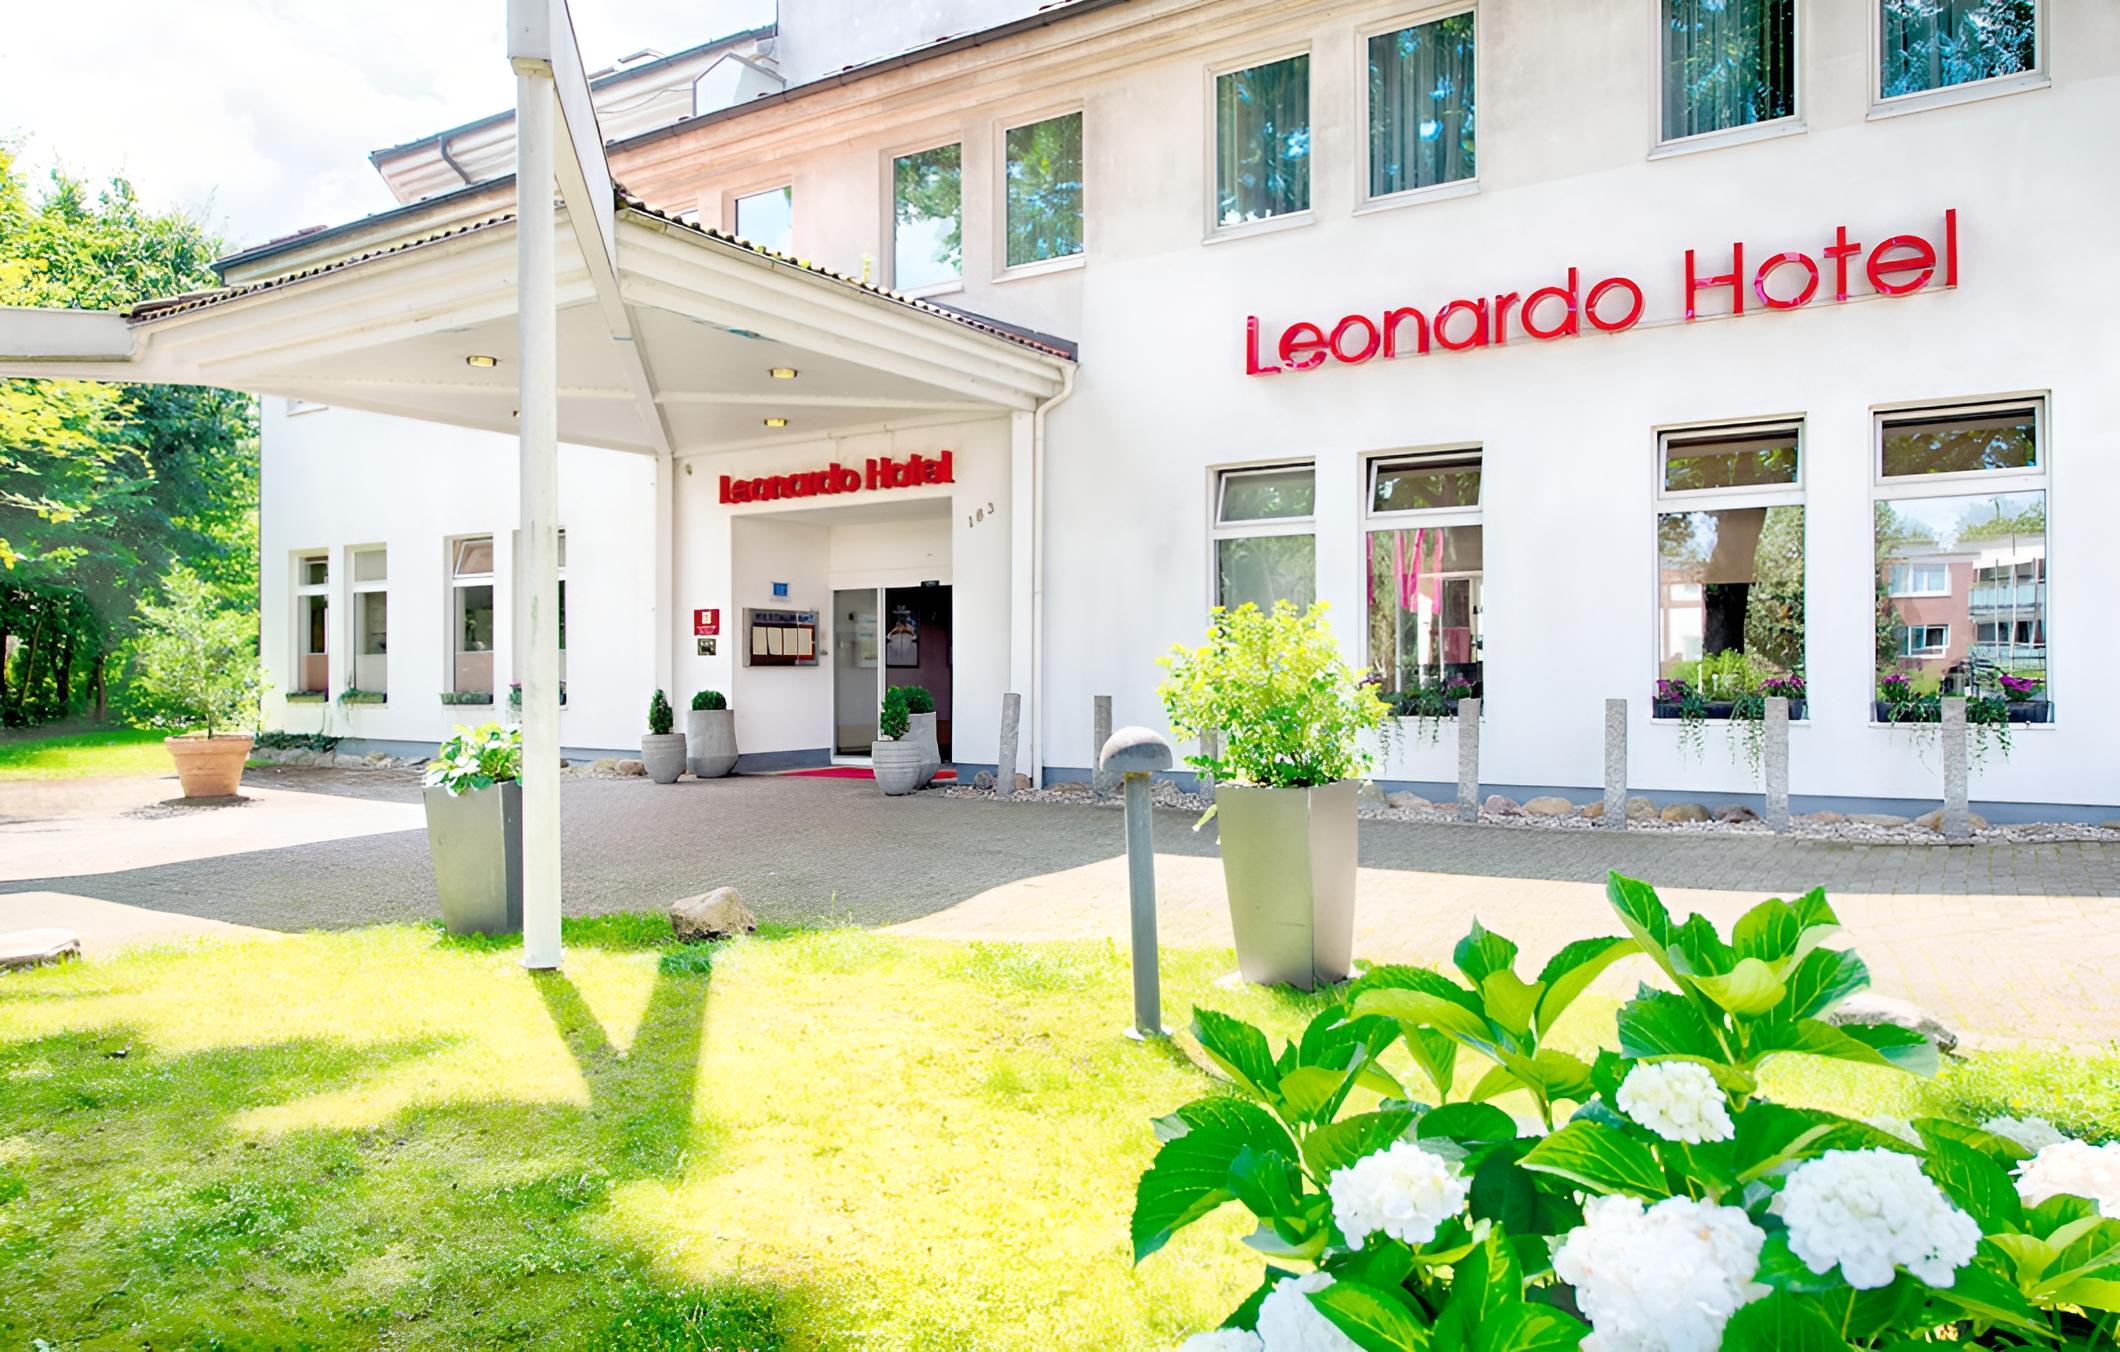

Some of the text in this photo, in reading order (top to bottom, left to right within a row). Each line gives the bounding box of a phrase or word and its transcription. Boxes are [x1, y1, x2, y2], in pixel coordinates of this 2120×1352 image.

[1246, 208, 1959, 376] Leonardo Hotel
[719, 450, 955, 504] Leonardo Hotel
